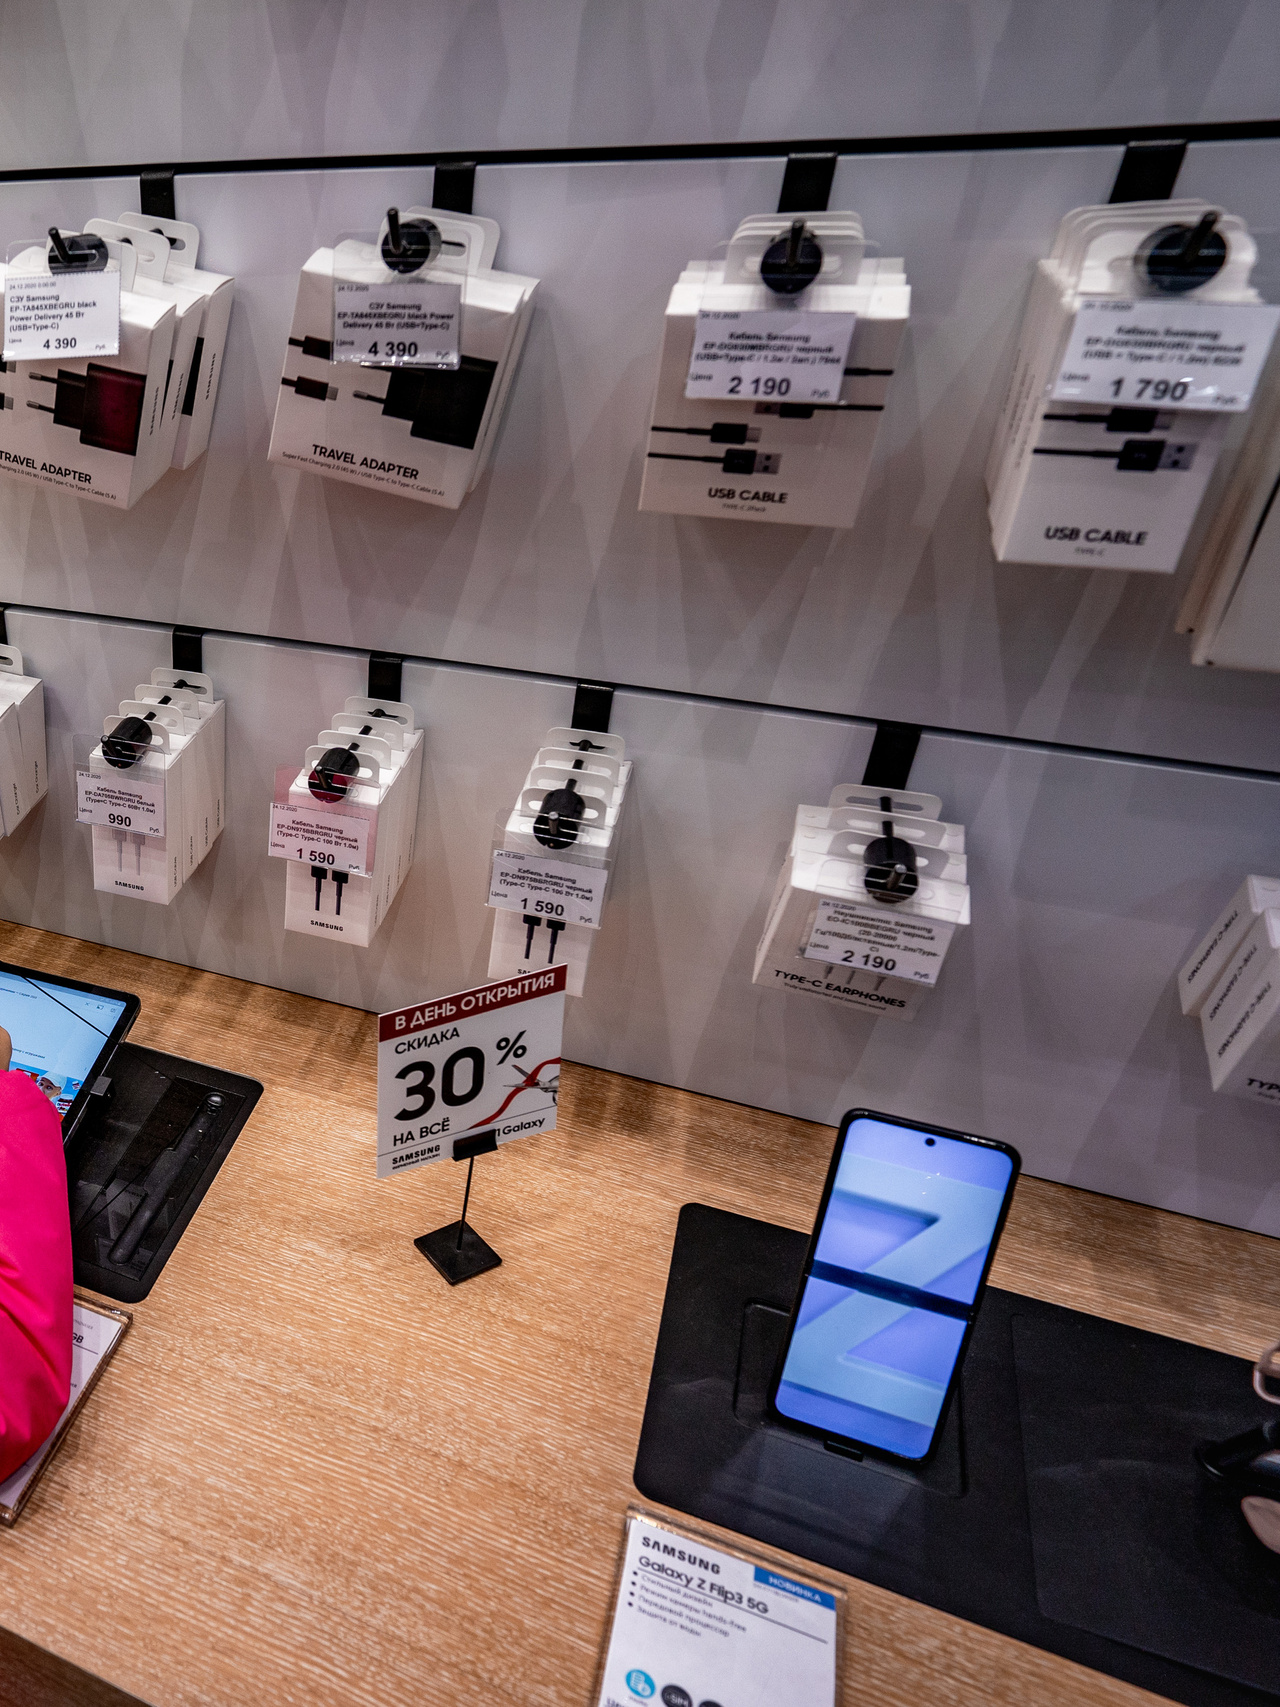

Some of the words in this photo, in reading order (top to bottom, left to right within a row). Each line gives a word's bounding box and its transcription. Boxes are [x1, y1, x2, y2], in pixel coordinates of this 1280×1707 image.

[34, 312, 63, 320] Delivery
[43, 339, 50, 349] 4
[55, 338, 76, 348] 390
[368, 342, 378, 356] 4
[386, 342, 418, 356] 390
[729, 376, 743, 394] 2
[751, 377, 791, 396] 190
[1111, 377, 1124, 397] 1
[1136, 378, 1189, 401] 790
[312, 444, 356, 465] TRAVEL
[360, 457, 419, 480] ADAPTER
[41, 463, 92, 484] ADAPTER
[53, 478, 69, 487] Type-C
[75, 485, 91, 493] Type-C
[92, 489, 105, 497] Cable
[708, 487, 735, 499] USB
[739, 490, 788, 503] CABLE
[1044, 526, 1080, 541] USB
[1085, 528, 1148, 546] CABLE
[97, 786, 116, 795] Кабель
[118, 790, 142, 800] Samsung
[108, 813, 131, 827] 990
[292, 820, 314, 828] Кабель
[315, 824, 343, 834] Samsung
[301, 834, 321, 844] Type-C
[297, 848, 303, 859] 1
[309, 850, 335, 865] 590
[115, 880, 144, 890] SAMSUNG
[518, 868, 543, 877] Кабель
[545, 873, 576, 884] Samsung
[527, 884, 550, 892] Type-C
[521, 898, 528, 909] 1
[535, 900, 564, 916] 590
[310, 920, 344, 931] SAMSUNG
[842, 950, 855, 962] 2
[862, 954, 897, 971] 190
[774, 969, 823, 988] TYPE-C
[825, 982, 907, 1008] EARPHONES
[395, 1016, 406, 1031] В
[410, 1002, 457, 1028] ДЕНЬ
[460, 973, 555, 1011] ОТКРЫТИЯ
[394, 1027, 460, 1054] СКИДКА
[393, 1131, 415, 1146] НА
[419, 1117, 450, 1138] ВСЁ
[502, 1118, 546, 1135] Galaxy
[392, 1145, 441, 1165] SAMSUNG
[641, 1536, 721, 1575] SAMSUNG
[639, 1556, 693, 1588] Galaxy
[697, 1578, 706, 1590] Z
[709, 1583, 743, 1605] Flip3
[747, 1598, 769, 1614] 5G
[768, 1576, 821, 1603] НОВИНКА
